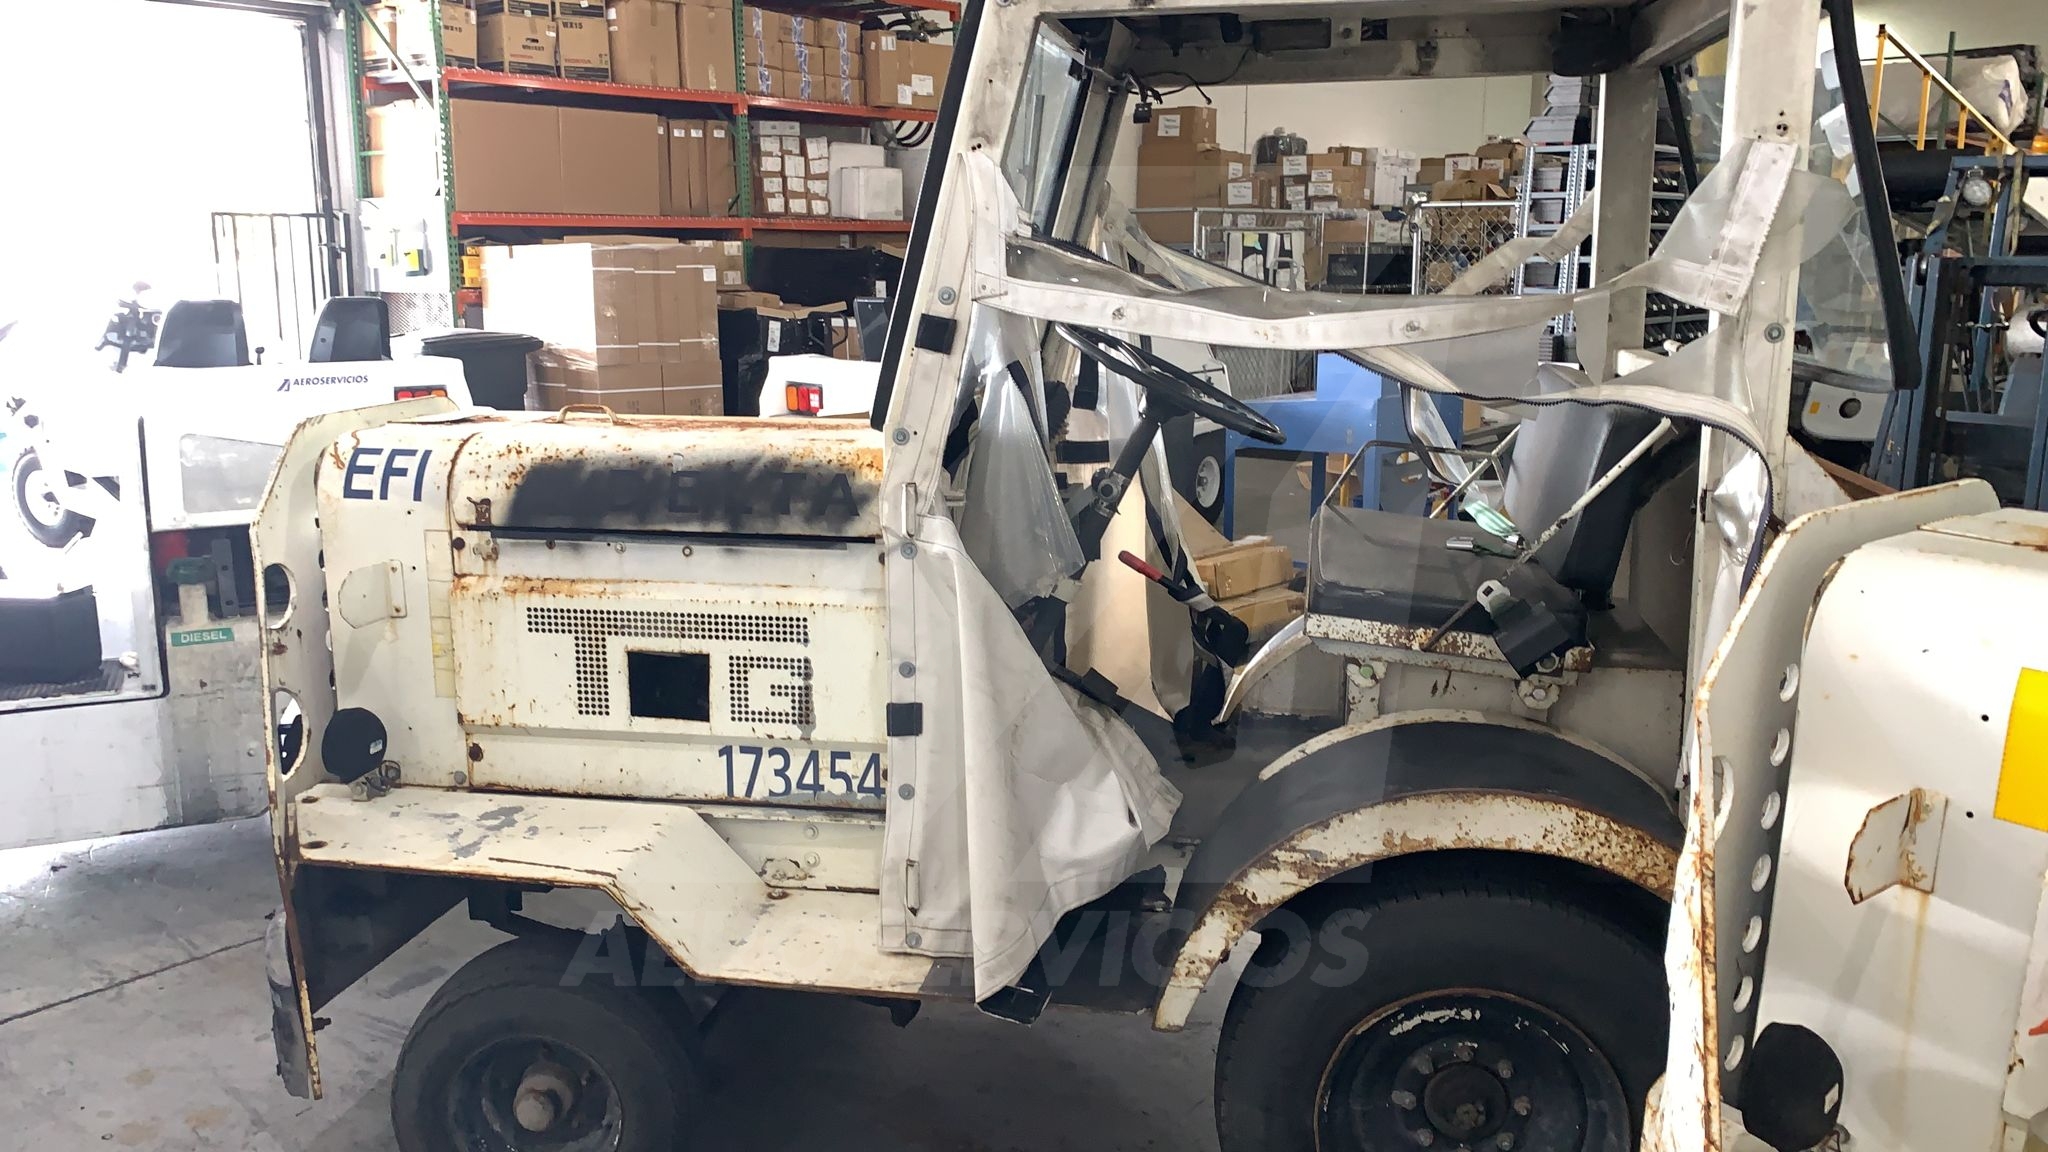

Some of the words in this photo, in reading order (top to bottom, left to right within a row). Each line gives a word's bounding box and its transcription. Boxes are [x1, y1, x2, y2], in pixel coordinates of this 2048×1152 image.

[562, 21, 583, 29] WX15
[293, 375, 368, 386] AEROSERVICIOS
[342, 447, 433, 502] EFI
[180, 630, 228, 643] DIESEL
[718, 744, 887, 800] 173454
